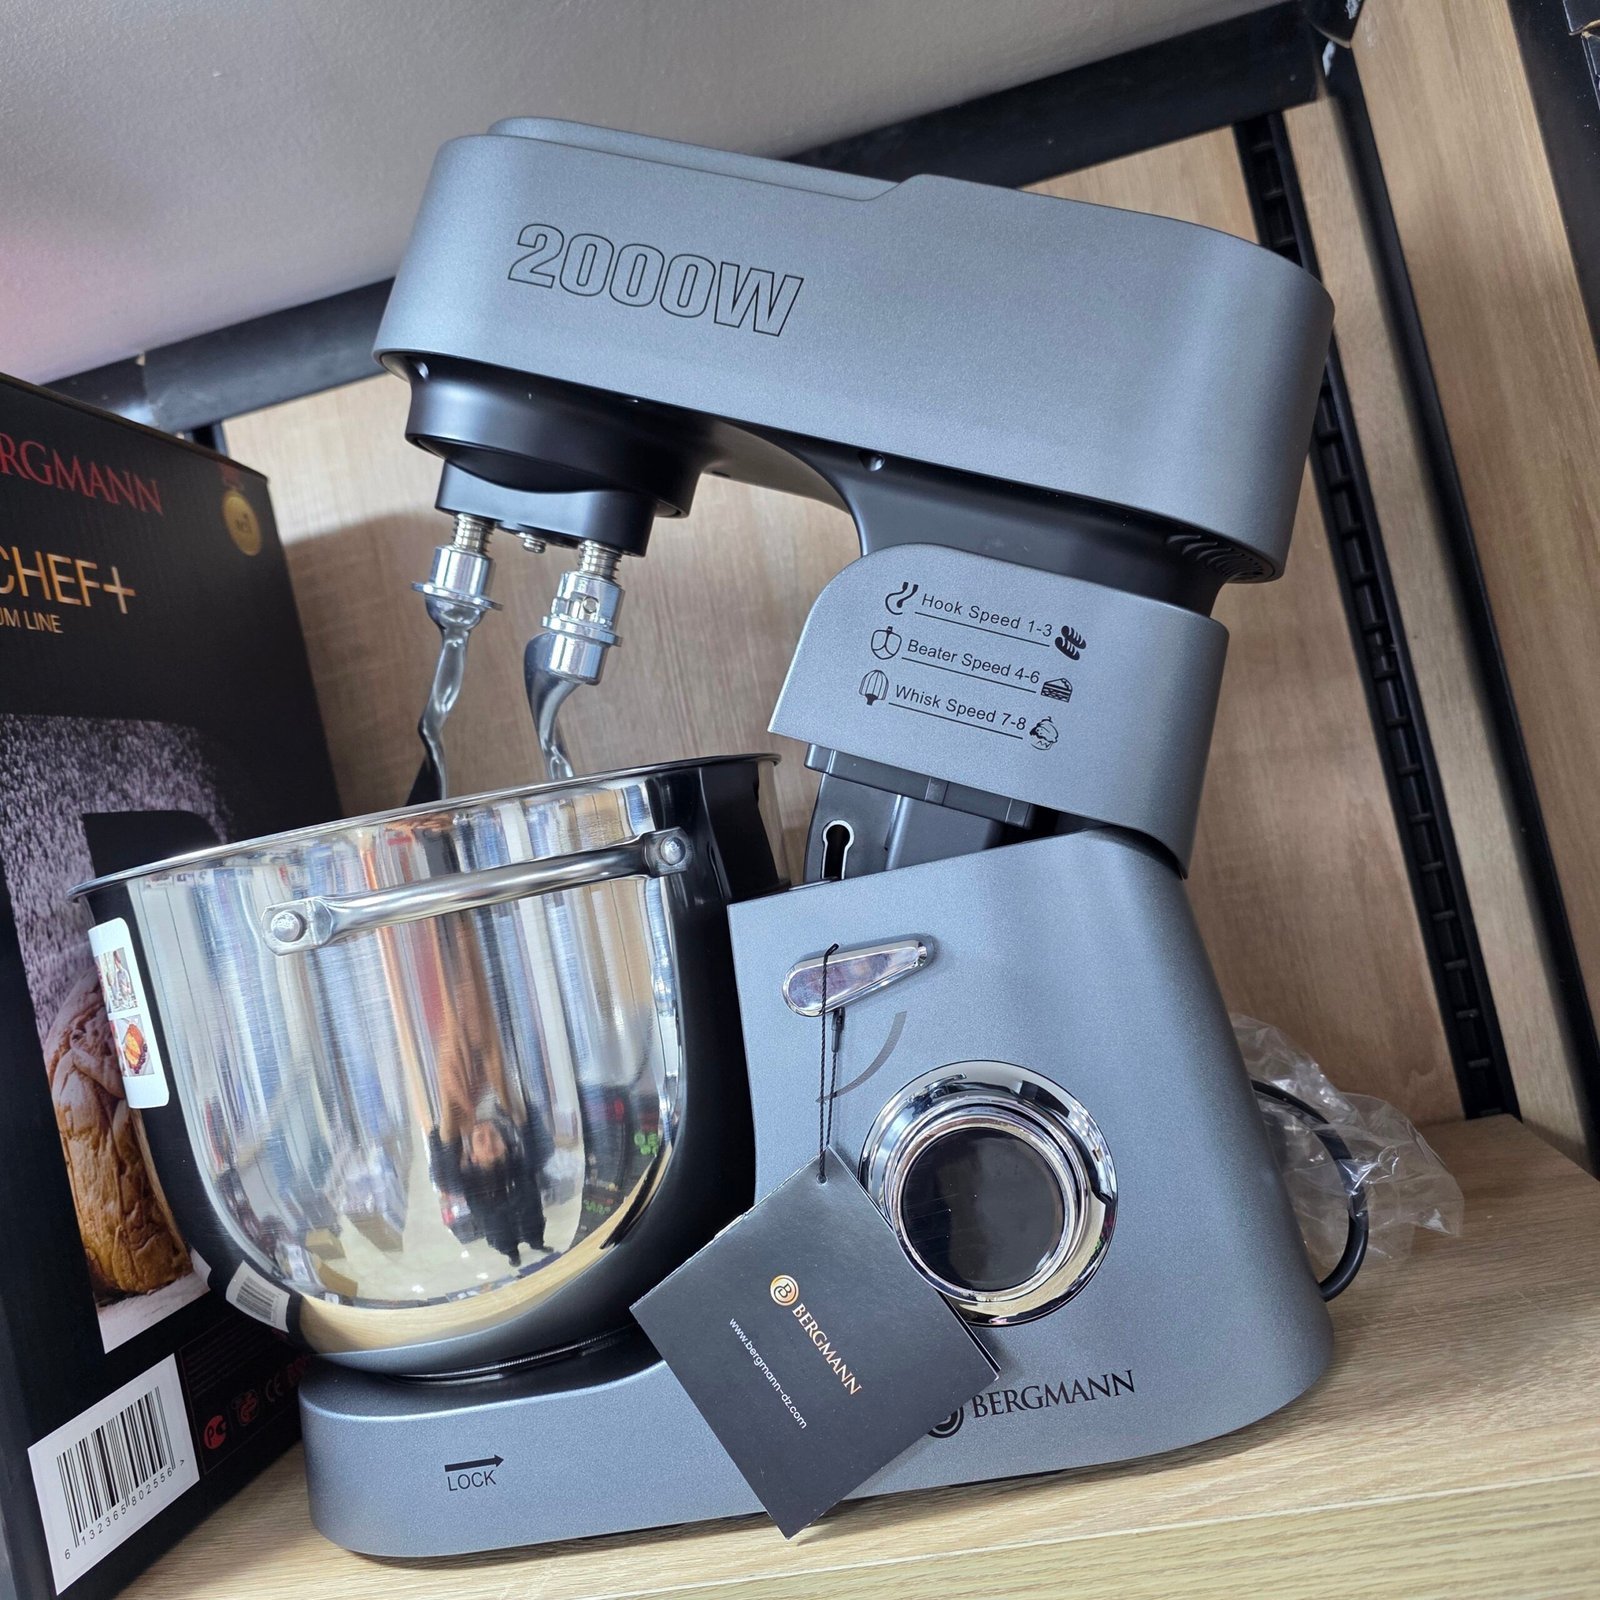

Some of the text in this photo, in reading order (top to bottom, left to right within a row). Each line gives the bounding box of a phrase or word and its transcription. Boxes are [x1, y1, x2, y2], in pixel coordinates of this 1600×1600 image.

[507, 223, 804, 337] 2000W
[23, 610, 64, 634] LINE
[921, 593, 1053, 637] Hook Speed 1-3
[907, 639, 1040, 684] Beater Speed 4-6
[895, 684, 1026, 731] Whisk Speed 7-8
[792, 1302, 863, 1396] BERGMANN
[729, 1318, 807, 1429] www.bergmann-dz.com
[971, 1369, 1135, 1418] BERGMANN
[447, 1470, 496, 1491] LOCK
